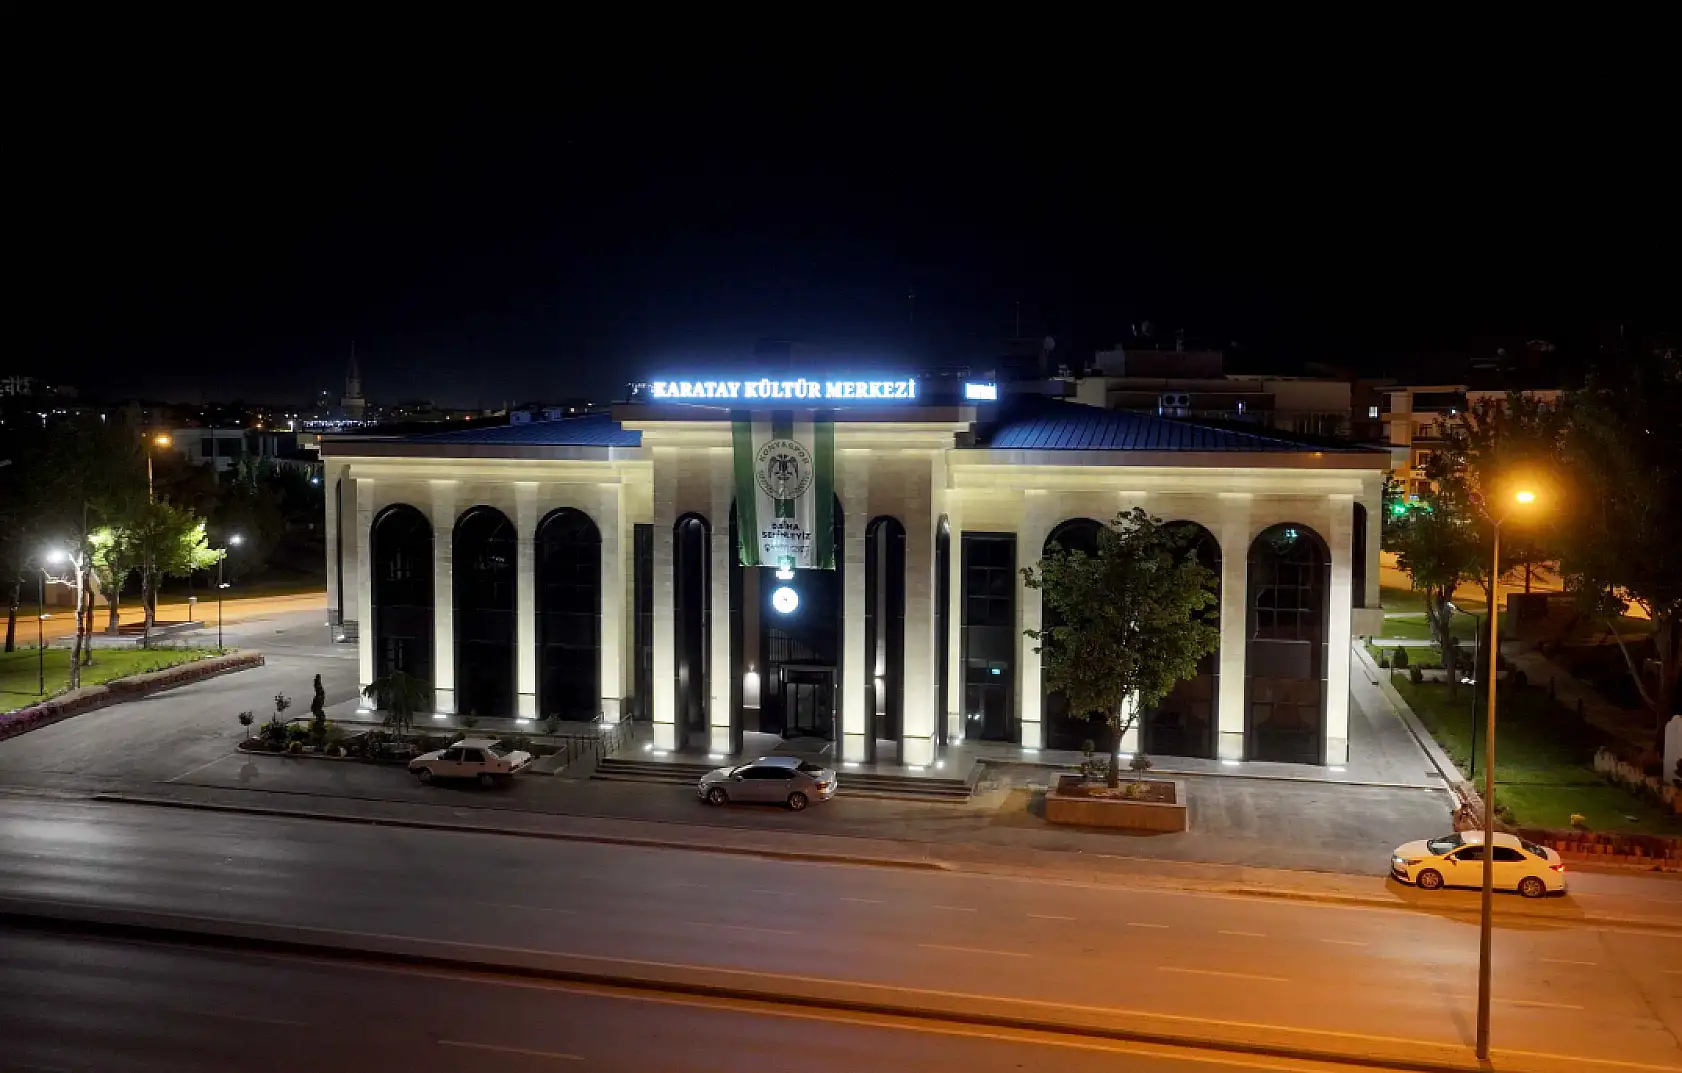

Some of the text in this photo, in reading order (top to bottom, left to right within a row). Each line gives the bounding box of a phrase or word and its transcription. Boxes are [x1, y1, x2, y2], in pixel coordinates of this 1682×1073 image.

[653, 381, 741, 398] KARATAY
[744, 378, 822, 398] KÜLTÜR
[826, 378, 916, 398] MERKEZİ
